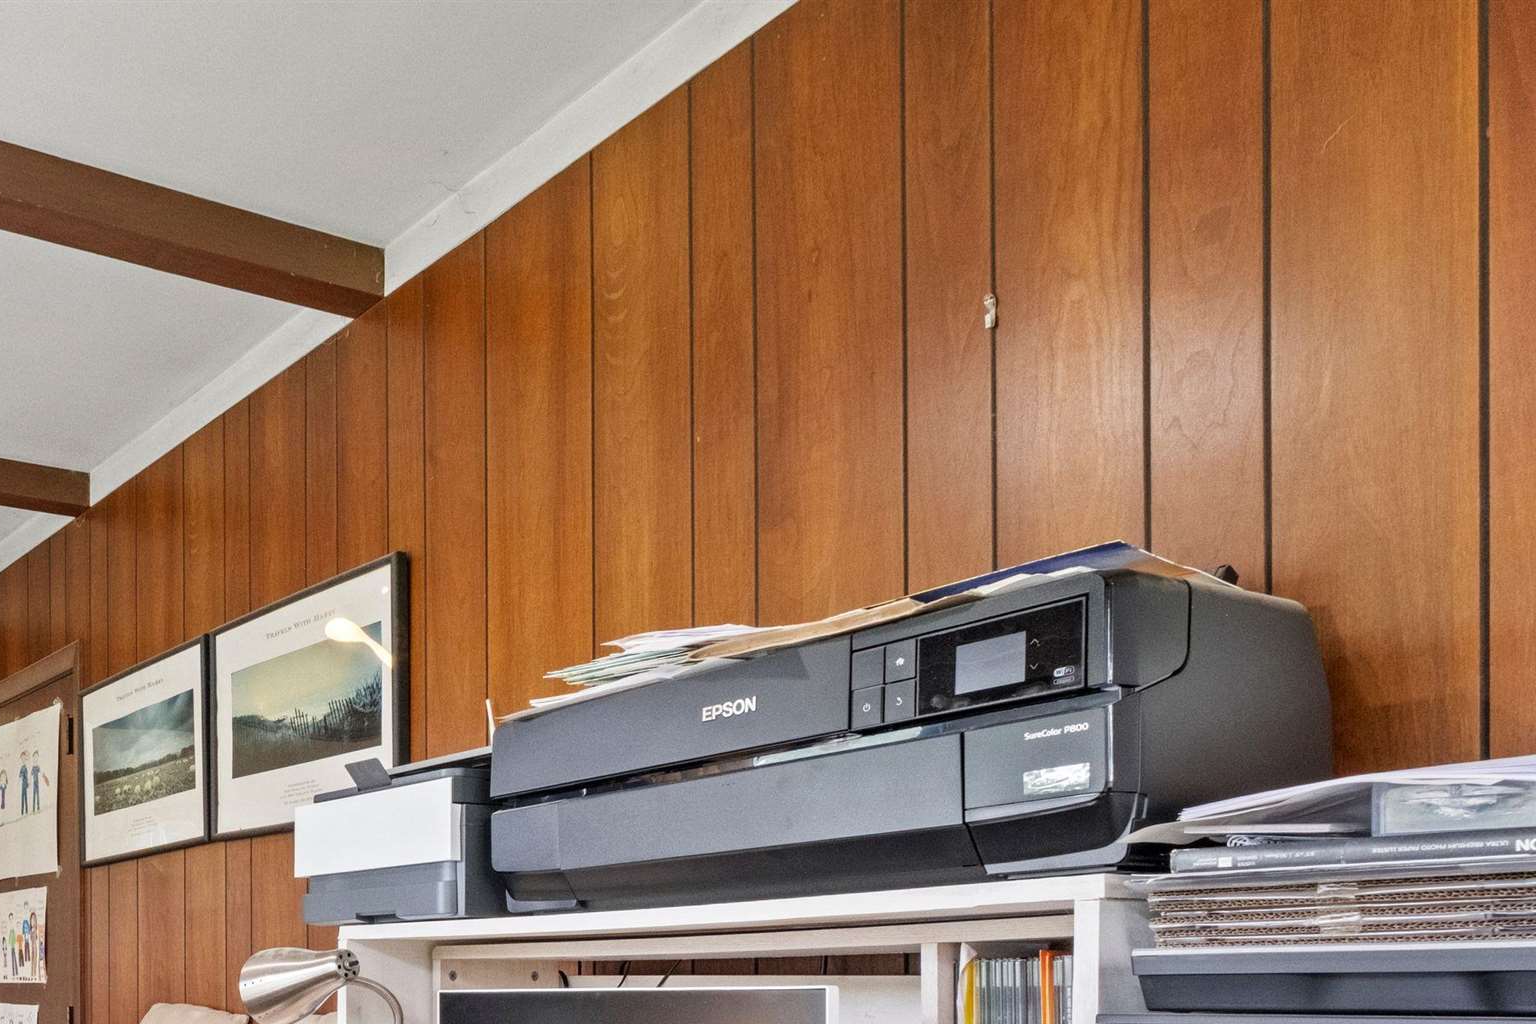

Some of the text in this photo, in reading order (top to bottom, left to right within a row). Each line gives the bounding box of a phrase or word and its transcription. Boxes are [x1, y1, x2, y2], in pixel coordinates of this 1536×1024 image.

[701, 695, 757, 722] EPSON
[1023, 722, 1089, 741] SureColor P800
[1420, 843, 1447, 851] PHOTO
[1485, 839, 1509, 848] ULTRA
